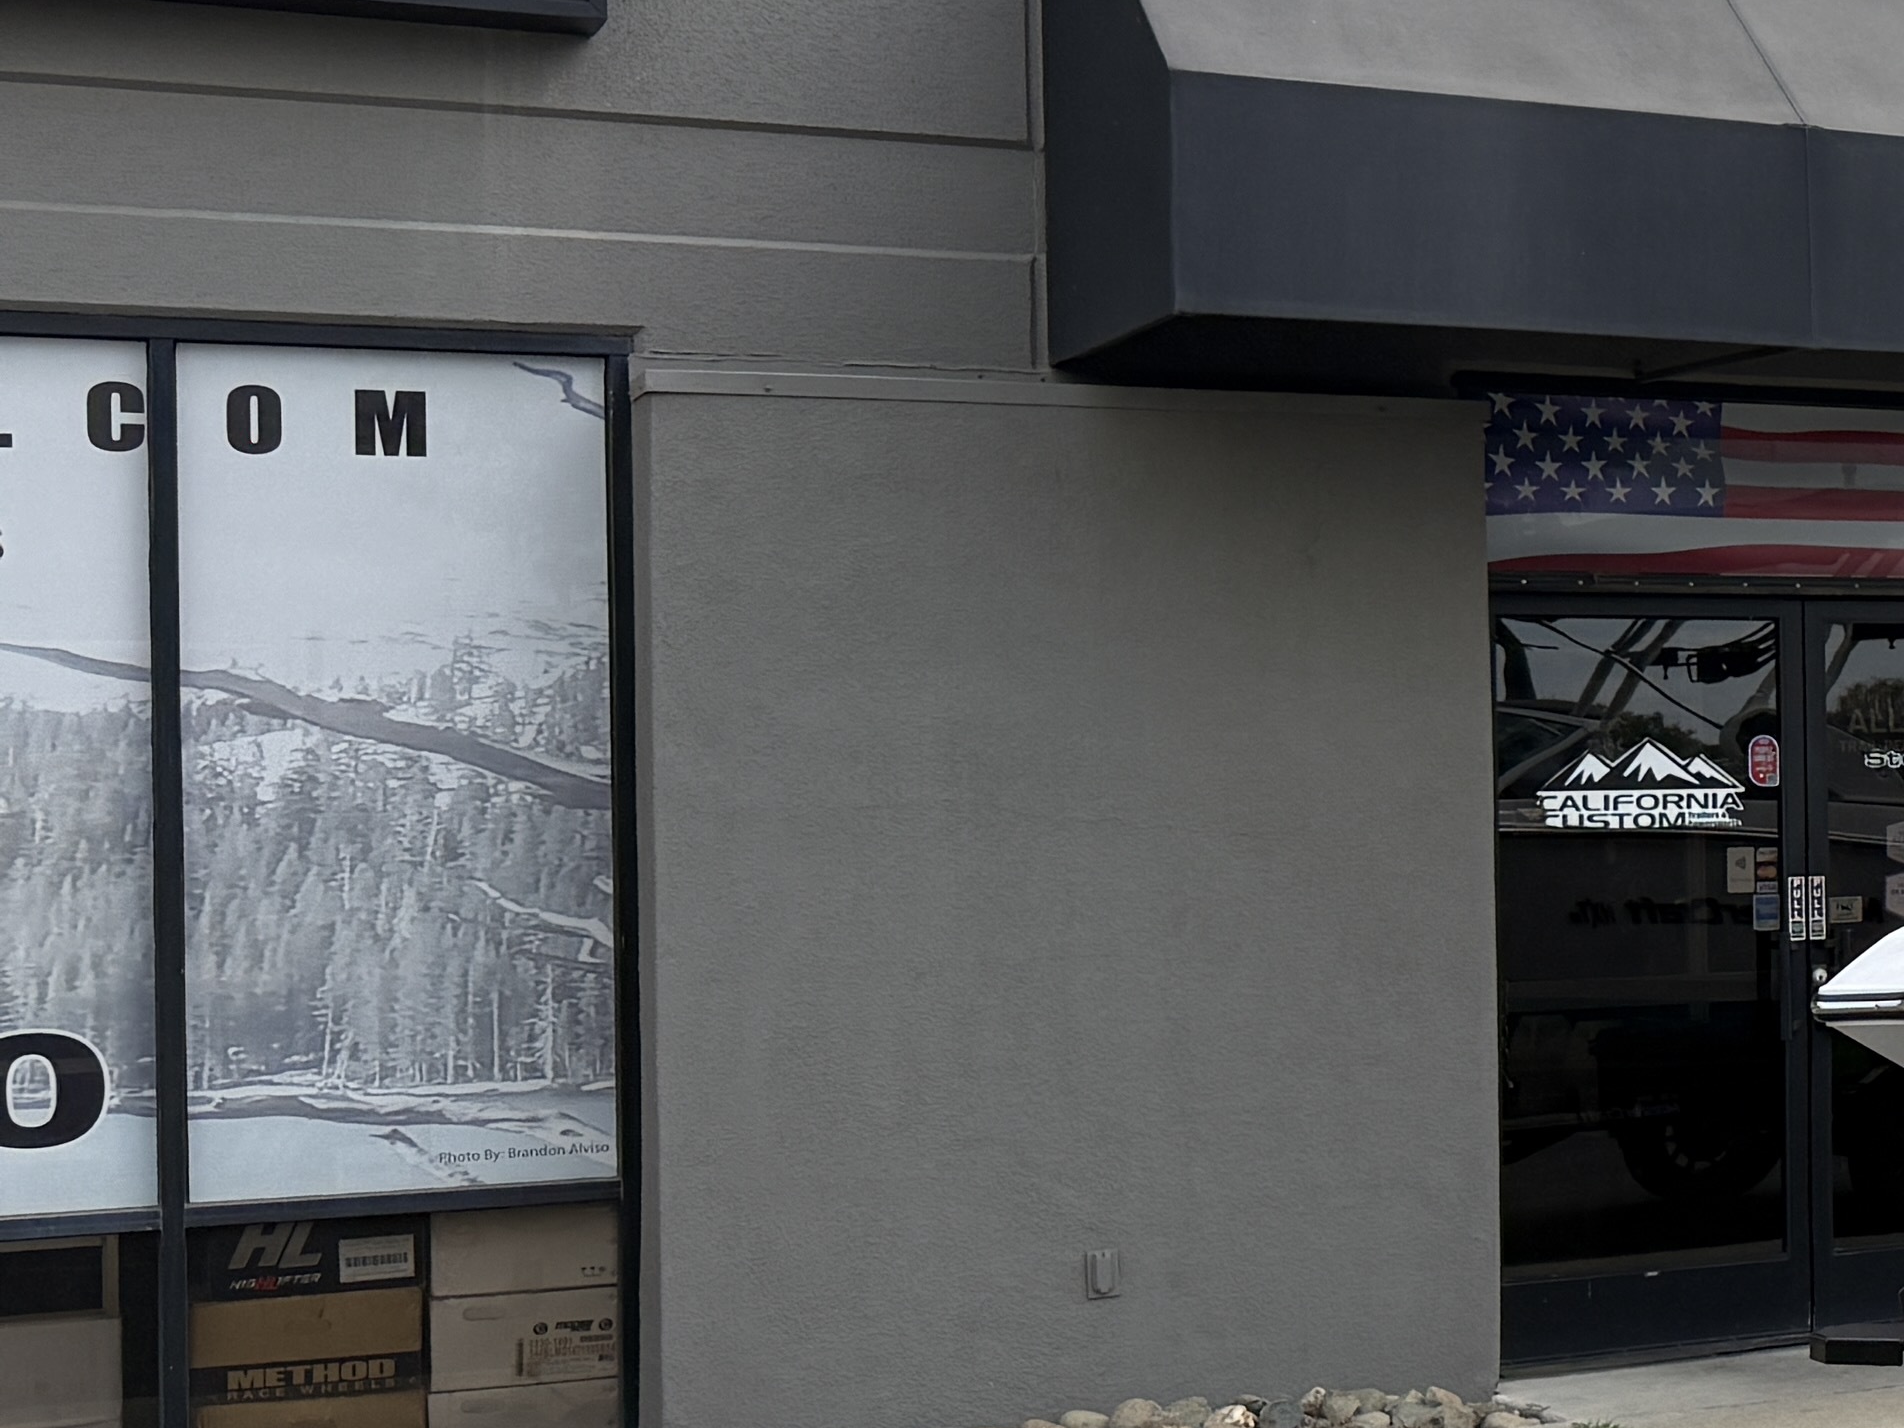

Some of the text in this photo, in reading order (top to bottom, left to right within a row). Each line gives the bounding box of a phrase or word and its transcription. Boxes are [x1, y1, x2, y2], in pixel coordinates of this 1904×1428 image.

[1540, 792, 1744, 812] CALIFORNIA
[1546, 811, 1686, 829] CUSTOM
[439, 1151, 481, 1165] Photo
[508, 1144, 566, 1160] Brandon
[568, 1139, 611, 1156] Alviso
[227, 1357, 396, 1391] METHOD
